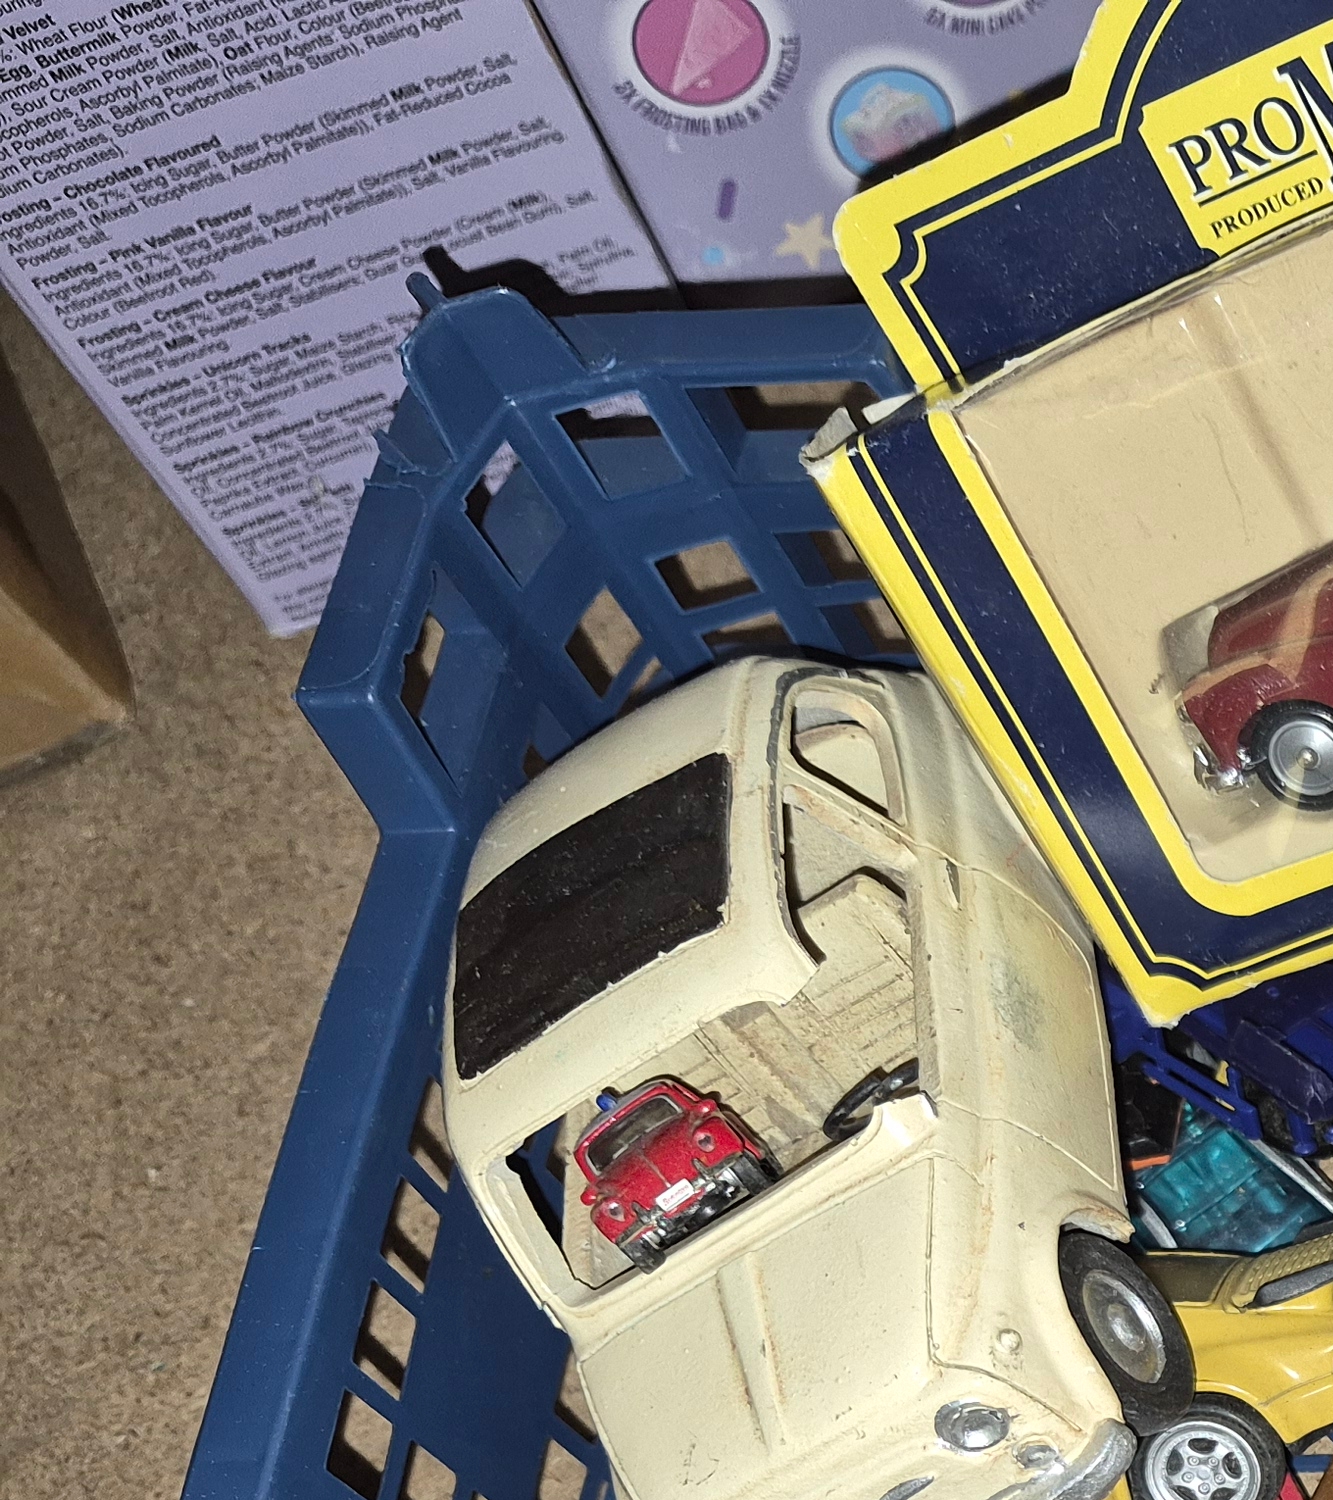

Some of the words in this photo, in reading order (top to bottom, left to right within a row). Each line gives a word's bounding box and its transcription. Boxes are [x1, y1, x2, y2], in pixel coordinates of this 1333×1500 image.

[1, 9, 56, 43] Velvet
[11, 92, 49, 119] Sour
[49, 73, 103, 105] Cream
[102, 53, 160, 86] Powder
[161, 36, 208, 67] (Milk,
[207, 23, 243, 50] Salt,
[281, 0, 327, 23] Lactic
[15, 26, 68, 58] Wheat
[67, 10, 110, 40] Flour
[34, 25, 121, 73] Buttermilk
[119, 4, 183, 43] Powder,
[48, 58, 86, 86] Milk
[85, 36, 150, 74] Powder,
[148, 23, 185, 51] Salt,
[185, 0, 268, 38] Antioxidant
[77, 78, 144, 118] Ascorbyl
[143, 50, 224, 93] Palmitate),
[222, 39, 255, 63] Oat
[254, 24, 298, 53] Flour,
[296, 5, 347, 36] Colour
[21, 127, 114, 174] Phosphates,
[113, 107, 171, 139] Sodium
[260, 60, 306, 87] Maize
[306, 38, 365, 73] Starch),
[364, 20, 421, 55] Raising
[419, 6, 464, 36] Agent
[73, 109, 111, 135] Salt,
[110, 90, 164, 123] Baking
[162, 71, 220, 103] Powder
[221, 49, 284, 85] (Raising
[282, 29, 339, 63] Agents:
[339, 8, 395, 40] Sodium
[61, 160, 144, 201] Chocolate
[142, 132, 222, 172] Flavoured
[129, 172, 168, 199] Icing
[216, 138, 261, 165] Butter
[261, 119, 317, 149] Powder
[317, 92, 390, 132] (Skimmed
[389, 80, 423, 104] Milk
[1206, 173, 1330, 240] PRODUCED
